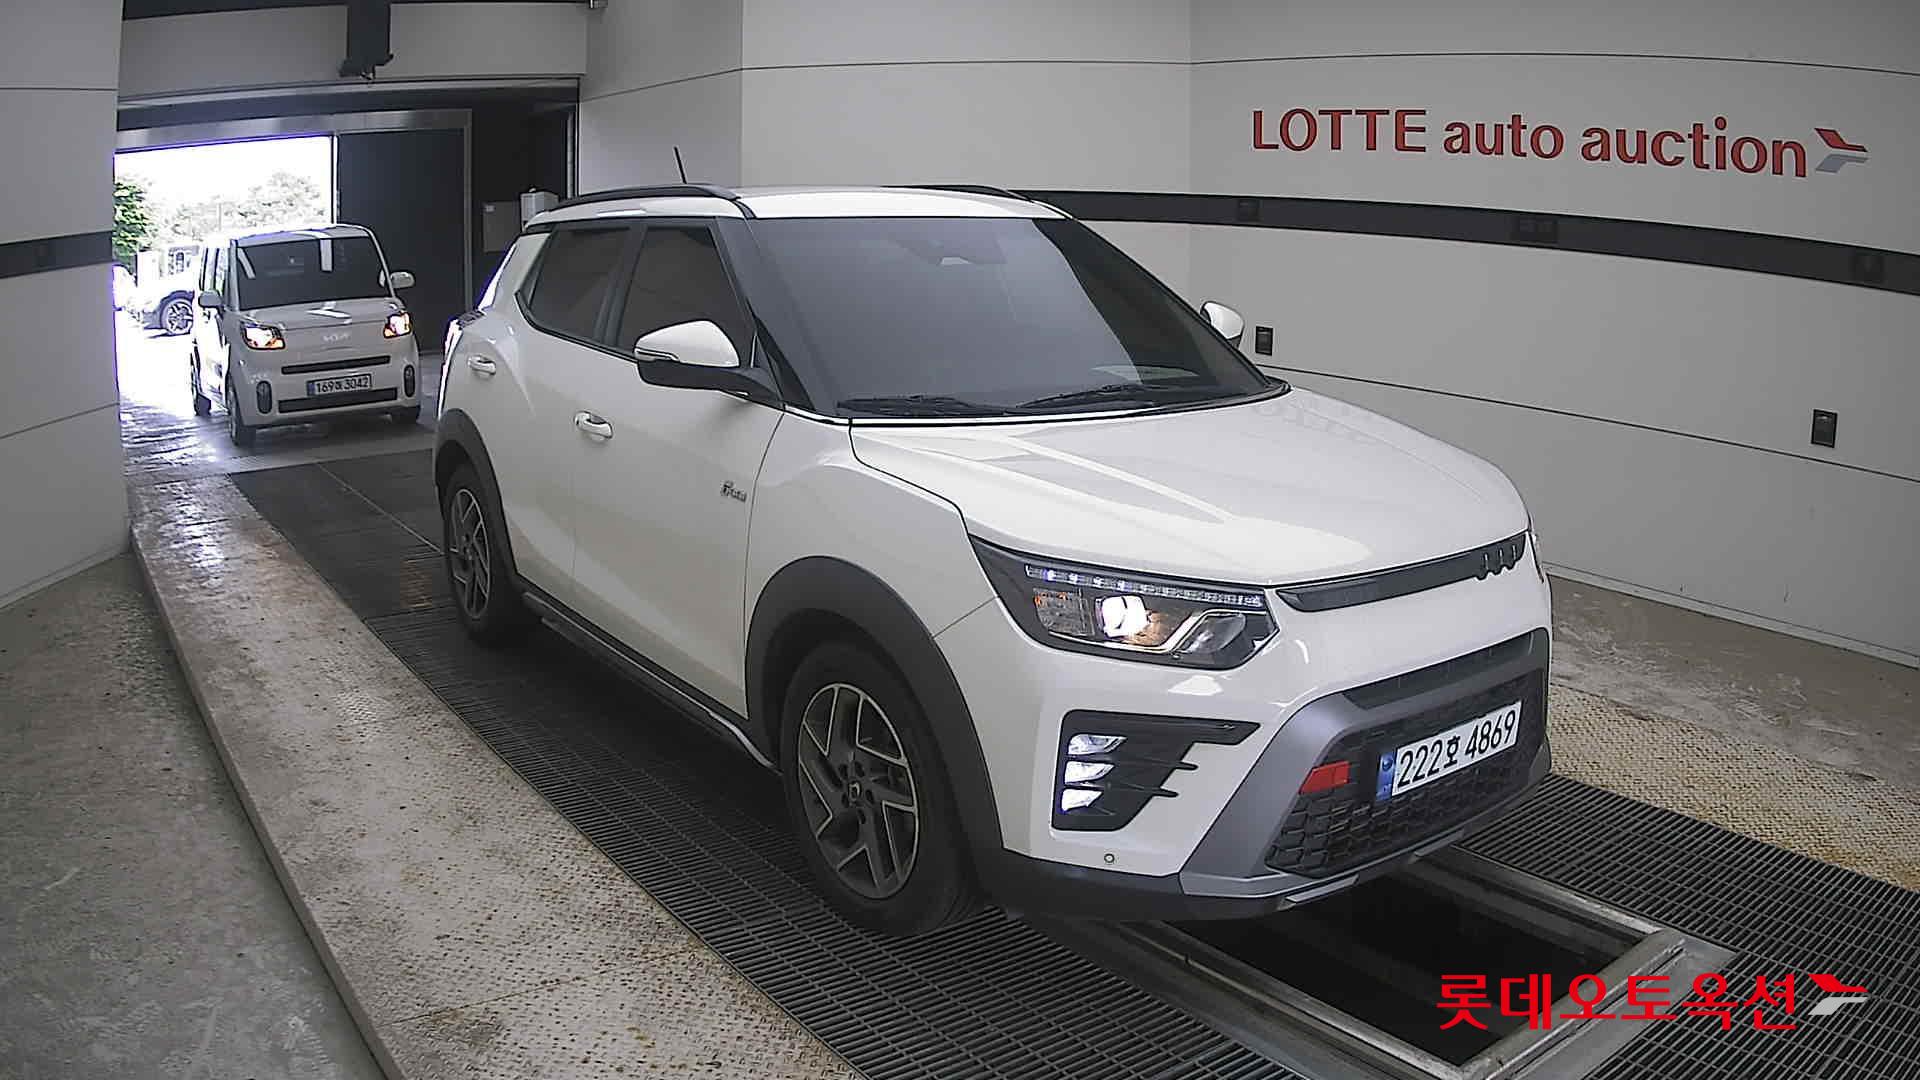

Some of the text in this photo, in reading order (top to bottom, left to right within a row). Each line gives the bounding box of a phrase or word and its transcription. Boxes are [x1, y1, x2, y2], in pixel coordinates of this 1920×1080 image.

[1252, 108, 1808, 178] LOTTE auto auction
[1397, 709, 1516, 788] 222호 4869
